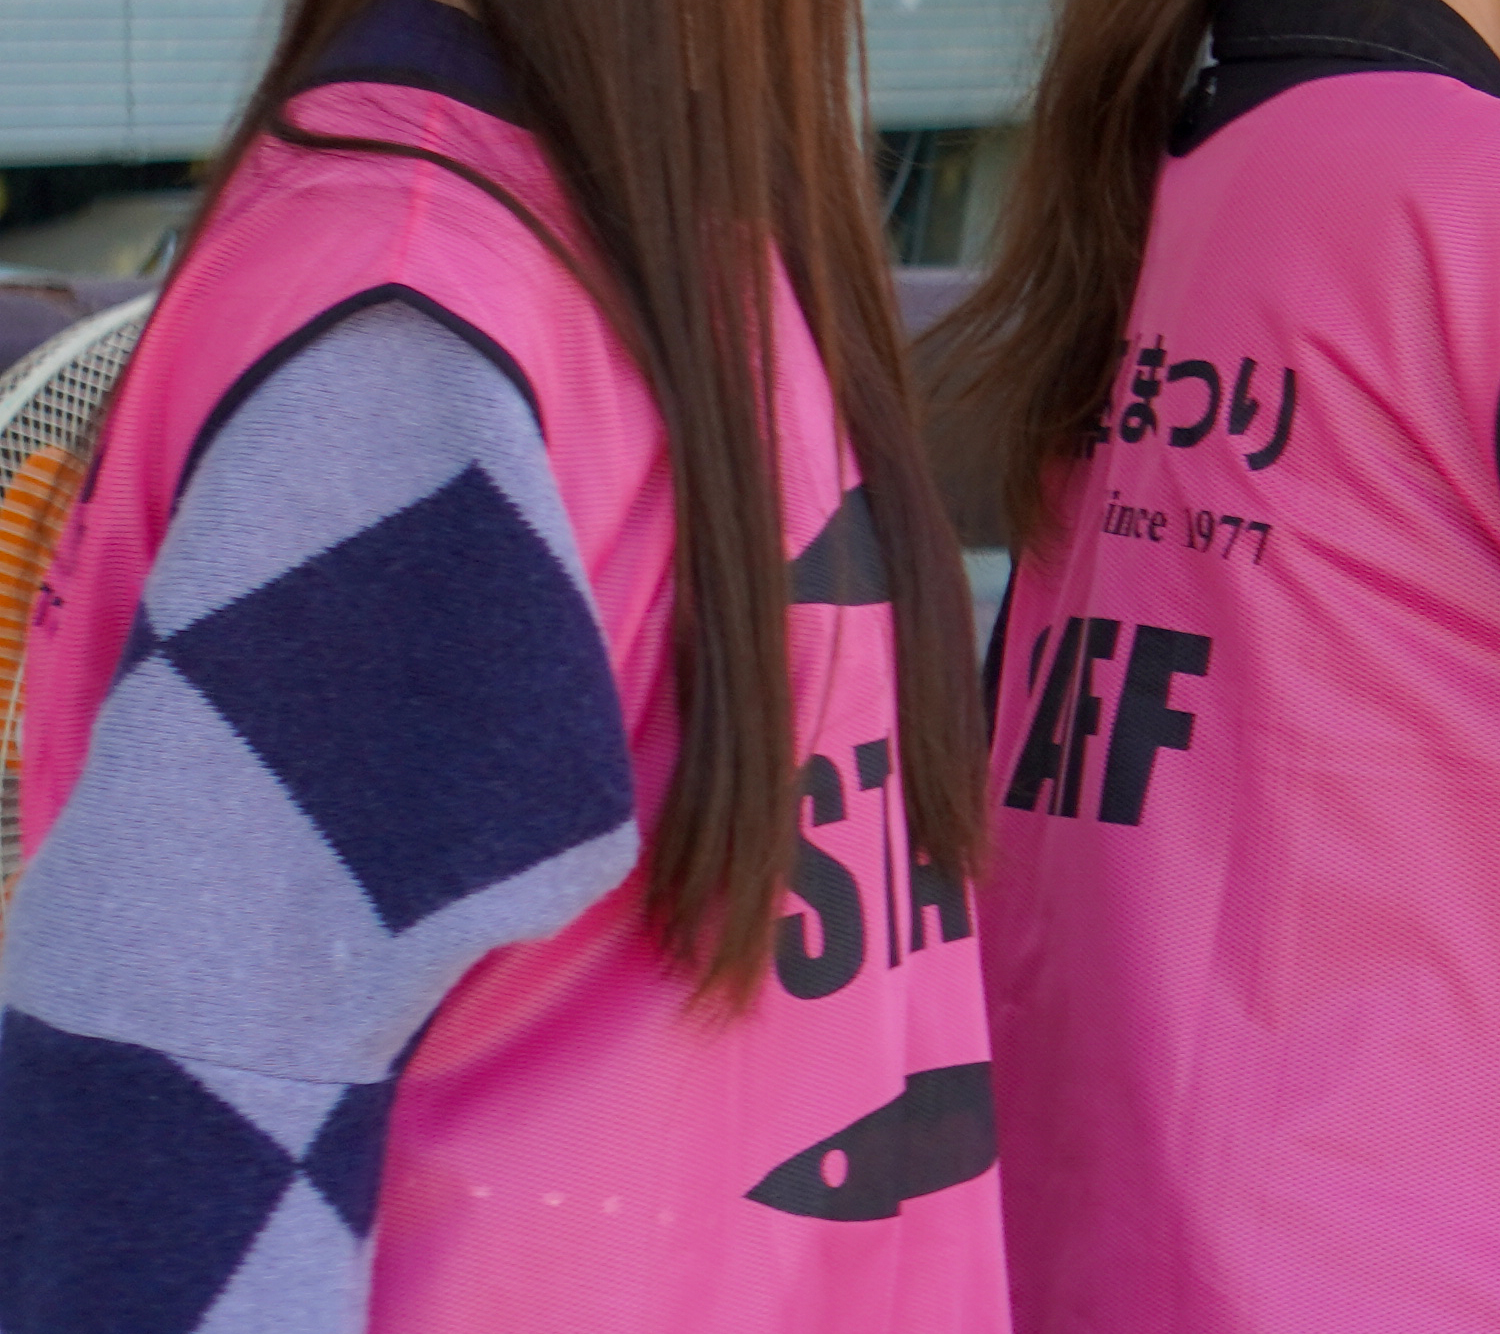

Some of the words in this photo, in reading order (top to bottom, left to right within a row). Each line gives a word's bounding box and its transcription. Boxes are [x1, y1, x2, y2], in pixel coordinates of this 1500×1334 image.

[1085, 334, 1297, 471] まつり
[1102, 490, 1168, 543] ince
[1181, 507, 1272, 565] 1977
[1003, 615, 1213, 827] AFF
